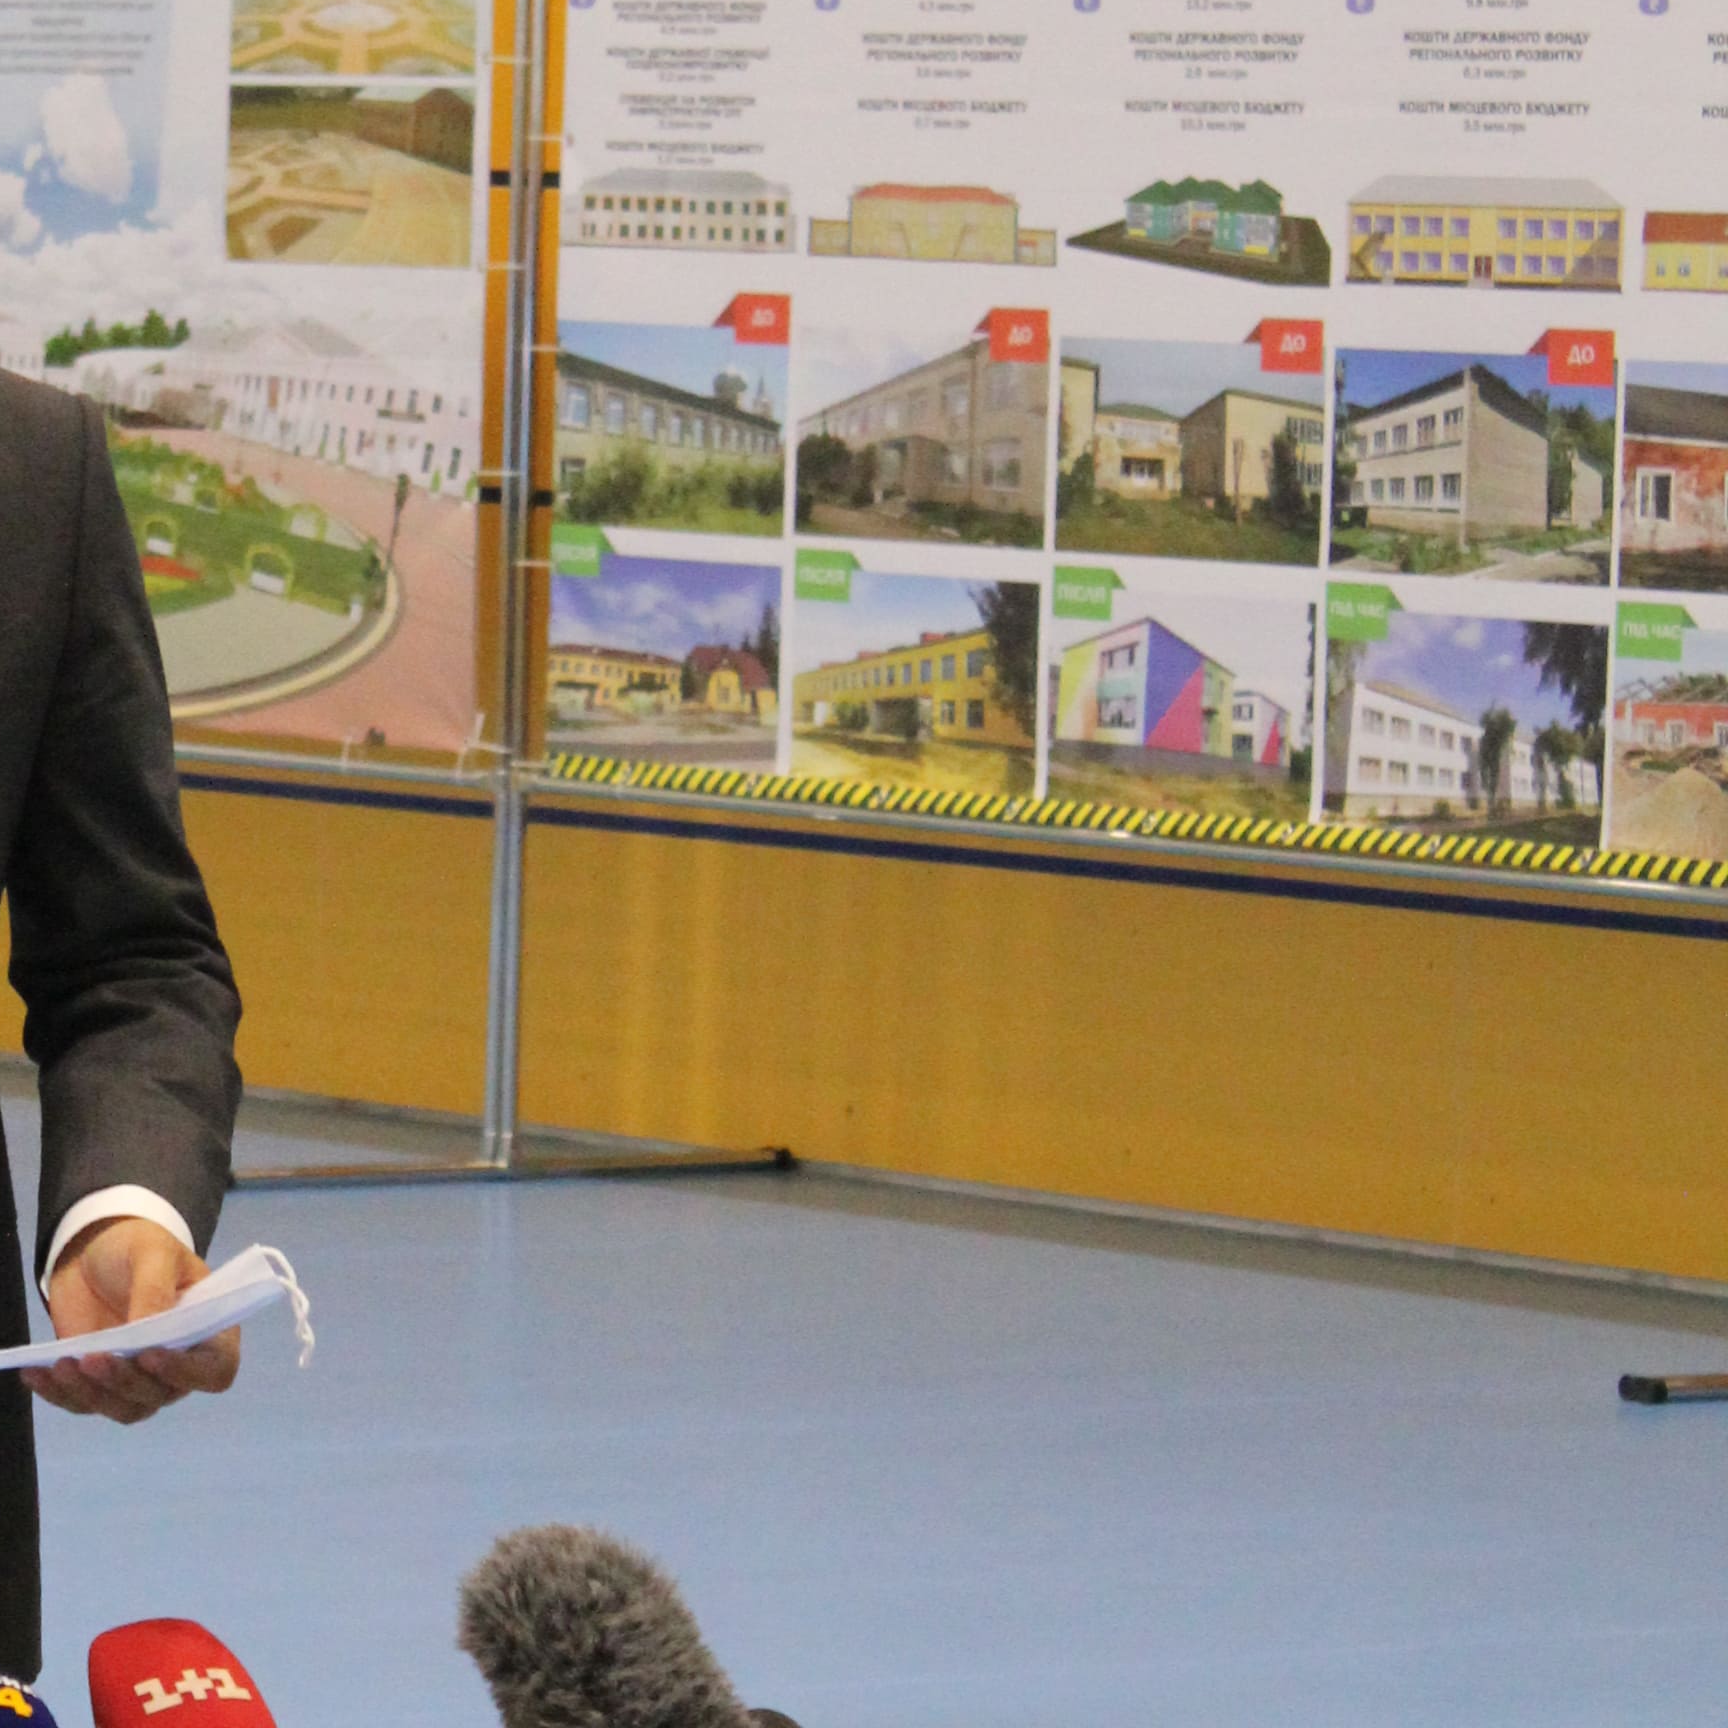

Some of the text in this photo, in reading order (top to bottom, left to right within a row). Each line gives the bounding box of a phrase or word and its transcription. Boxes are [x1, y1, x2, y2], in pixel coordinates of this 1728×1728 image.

[1279, 332, 1307, 354] ДО
[1567, 343, 1595, 365] ДО
[133, 1667, 252, 1715] 1+1
